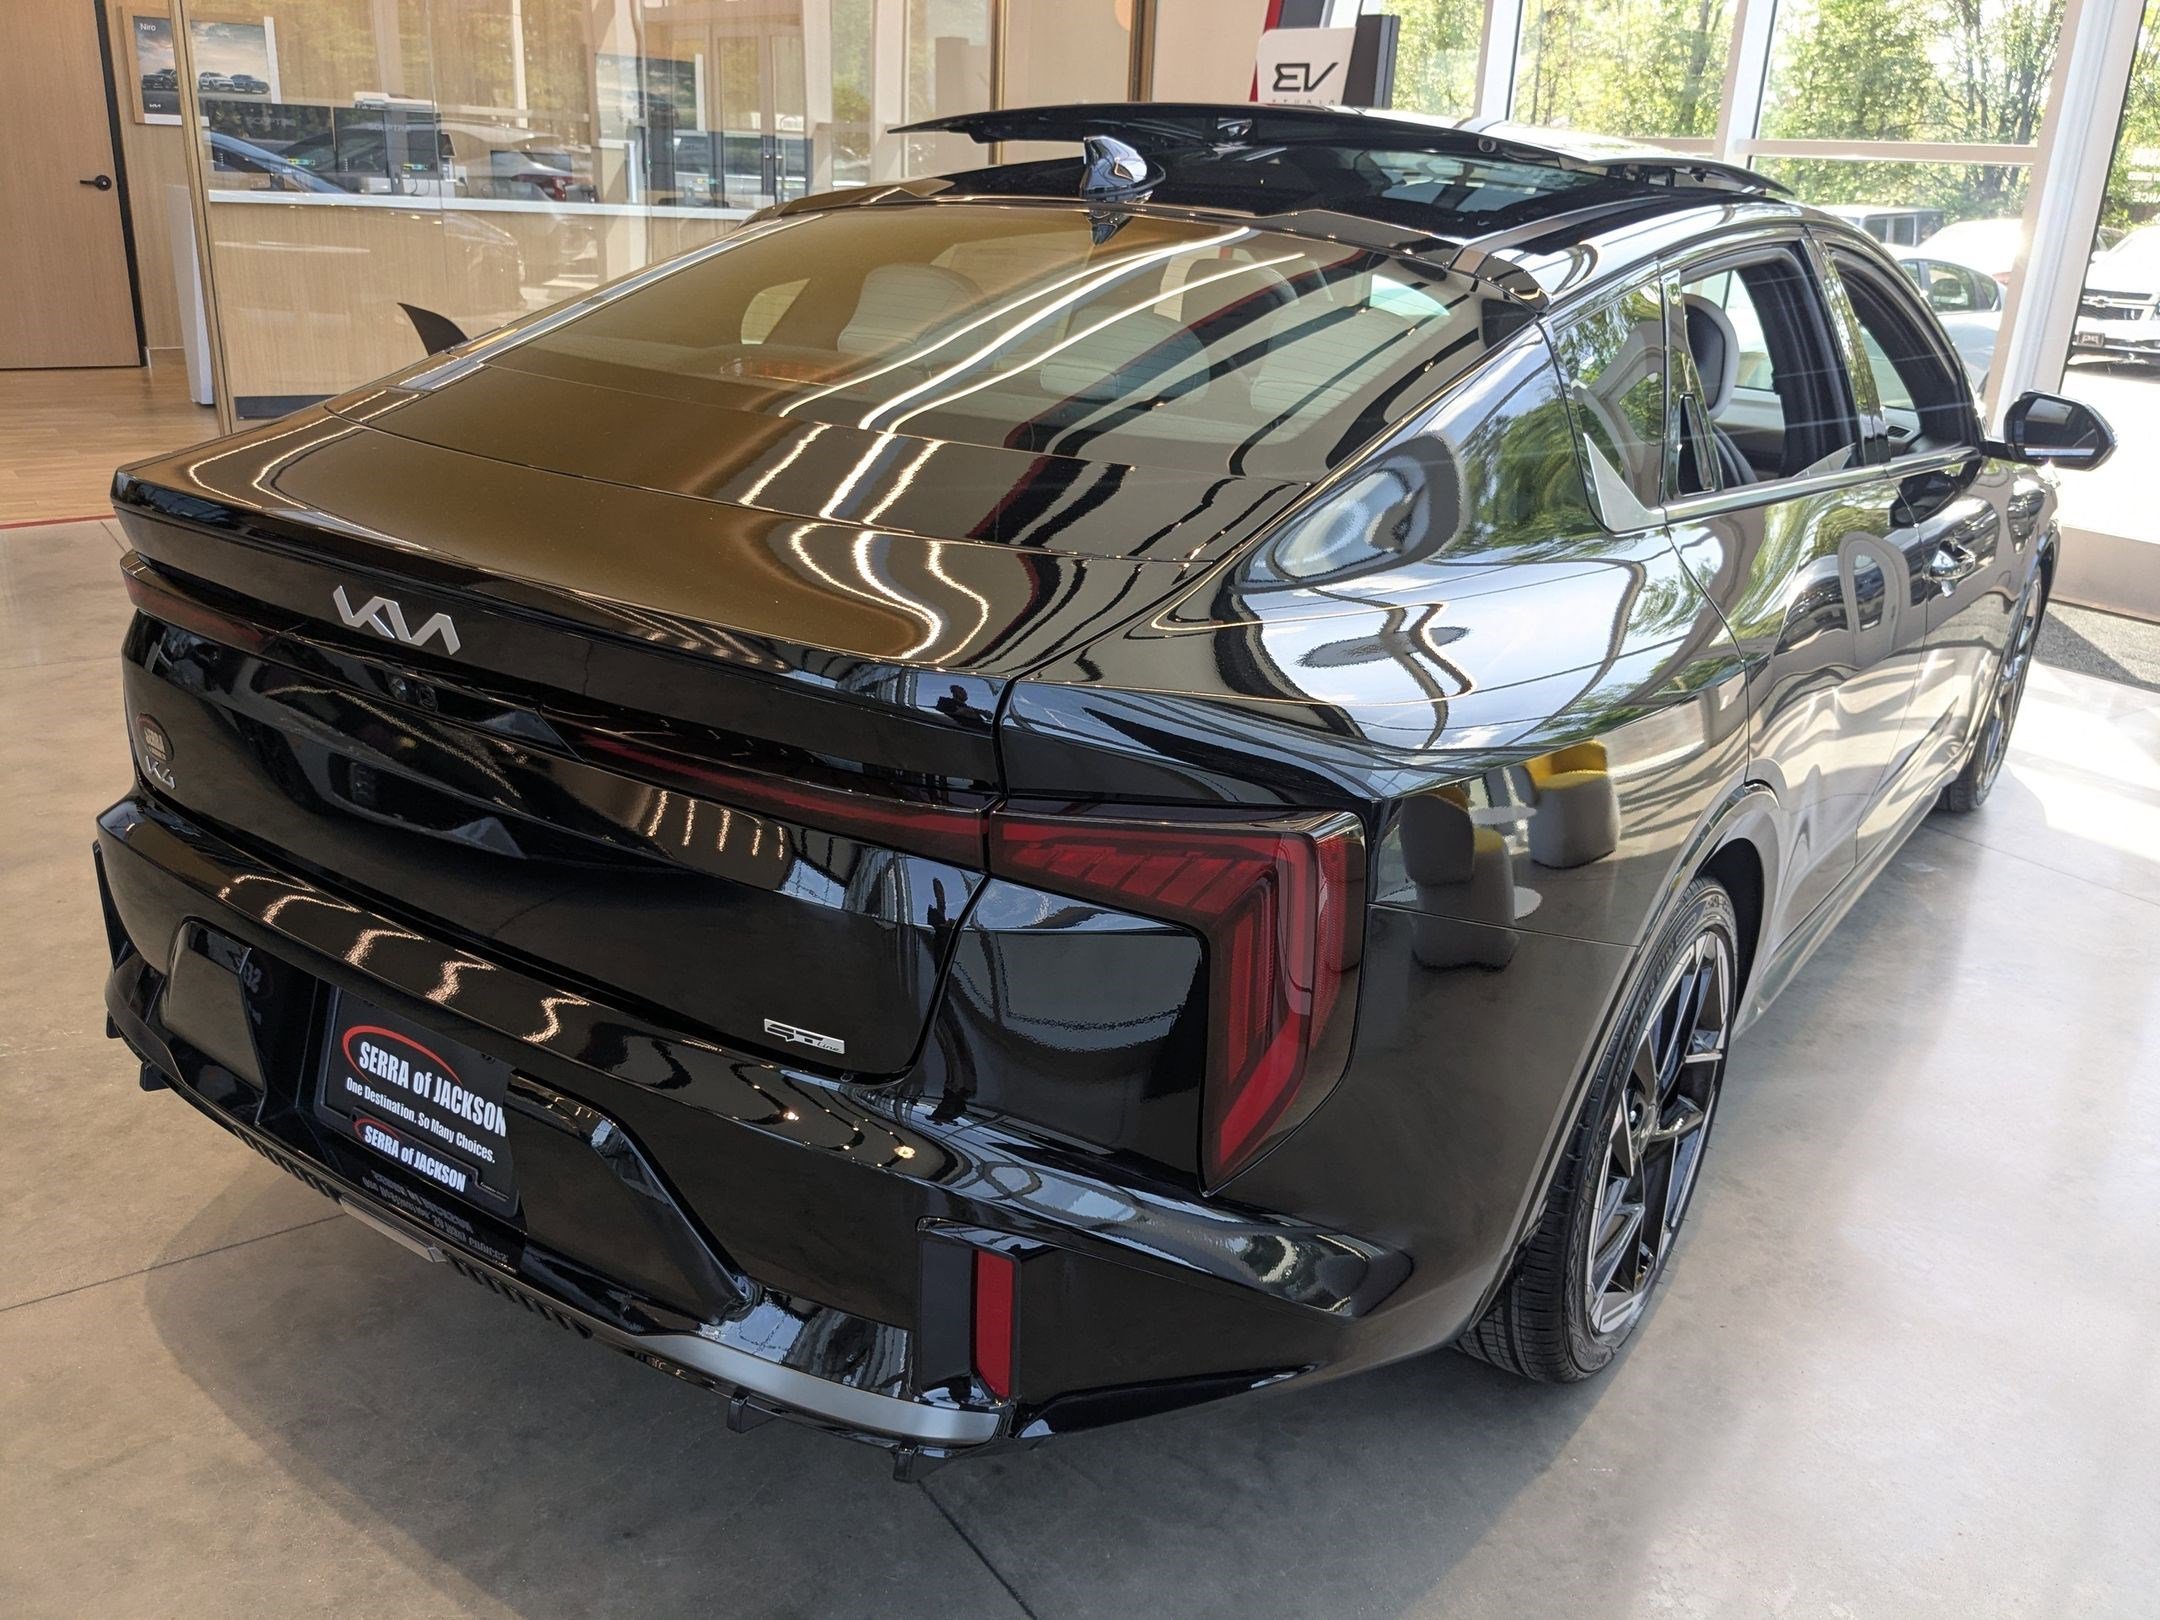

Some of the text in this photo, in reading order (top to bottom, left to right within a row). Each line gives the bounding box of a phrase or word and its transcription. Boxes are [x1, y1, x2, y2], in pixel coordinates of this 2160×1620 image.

[140, 22, 157, 32] Niro
[1272, 61, 1339, 92] EV
[333, 585, 461, 655] KIA
[145, 755, 176, 790] K4
[346, 1077, 496, 1164] One Destination. So Many Choices.
[359, 1041, 507, 1137] SERRA of JACKSON
[364, 1125, 399, 1158] SERRA
[401, 1146, 414, 1165] of
[414, 1152, 467, 1193] JACKSON
